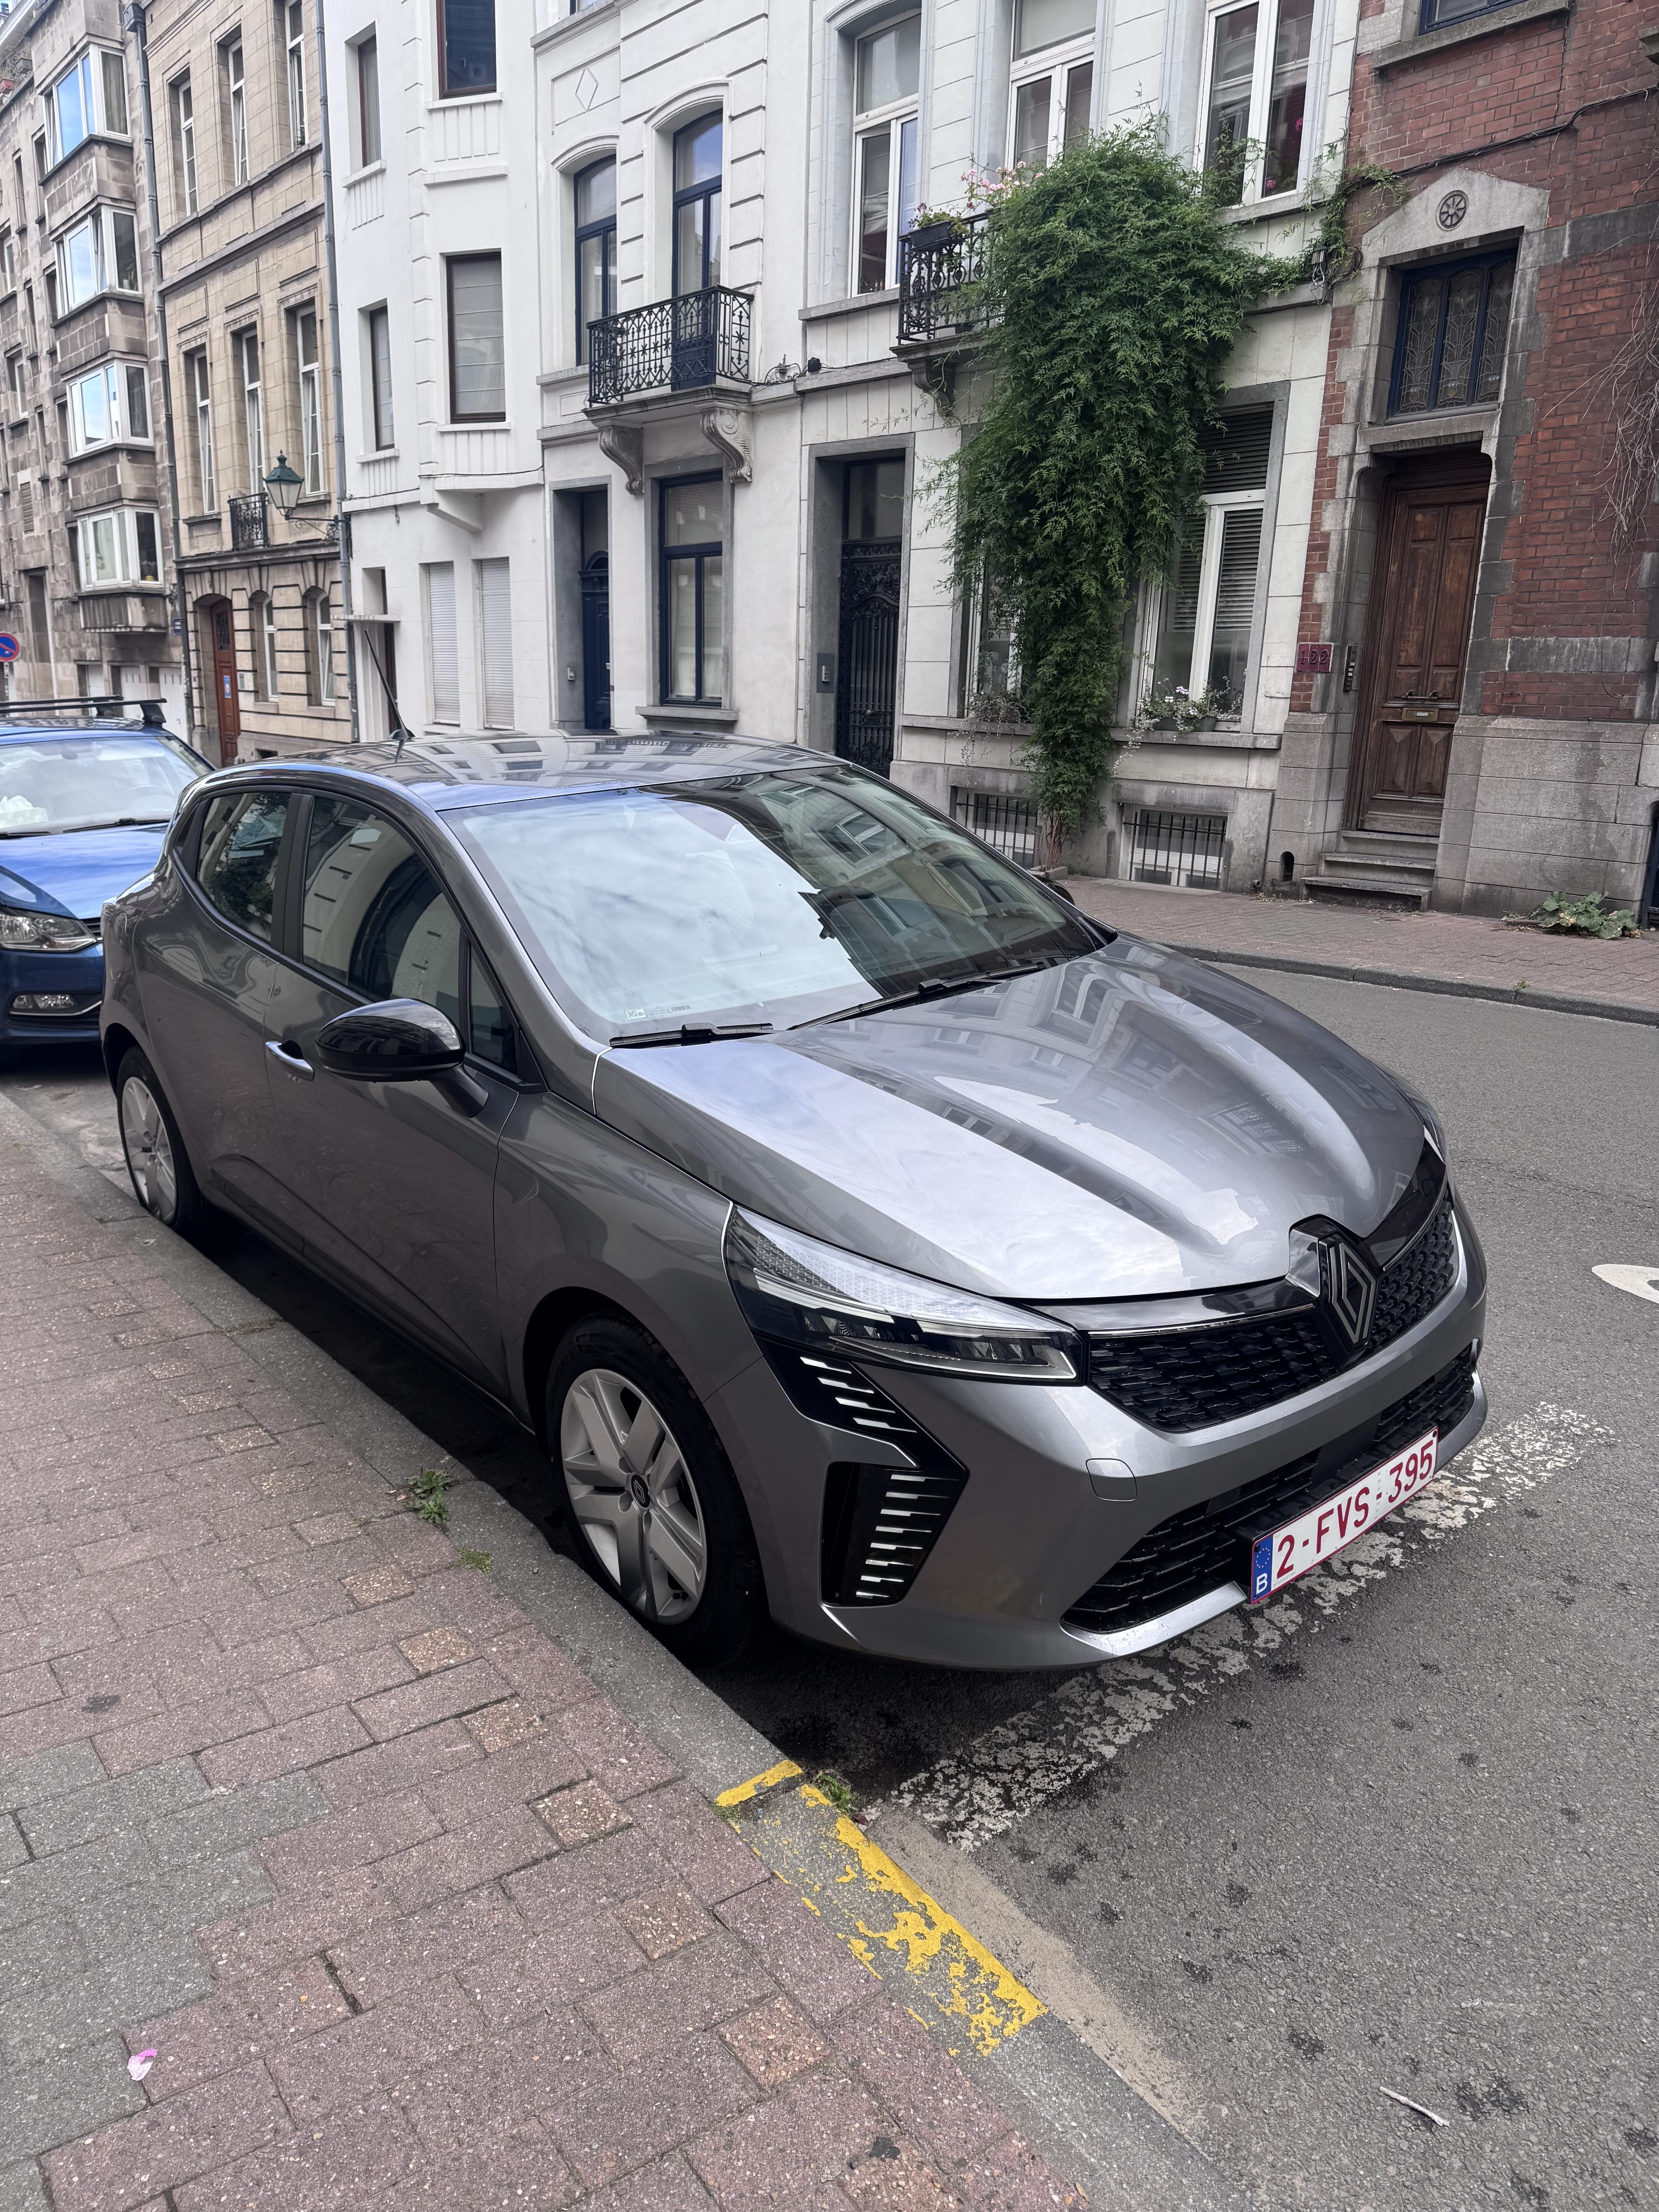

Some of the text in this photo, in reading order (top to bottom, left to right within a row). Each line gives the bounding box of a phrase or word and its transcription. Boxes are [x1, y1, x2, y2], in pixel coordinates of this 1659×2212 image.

[1301, 650, 1328, 665] 122
[1277, 1440, 1433, 1579] 2-FVS-395
[1256, 1573, 1267, 1595] B
